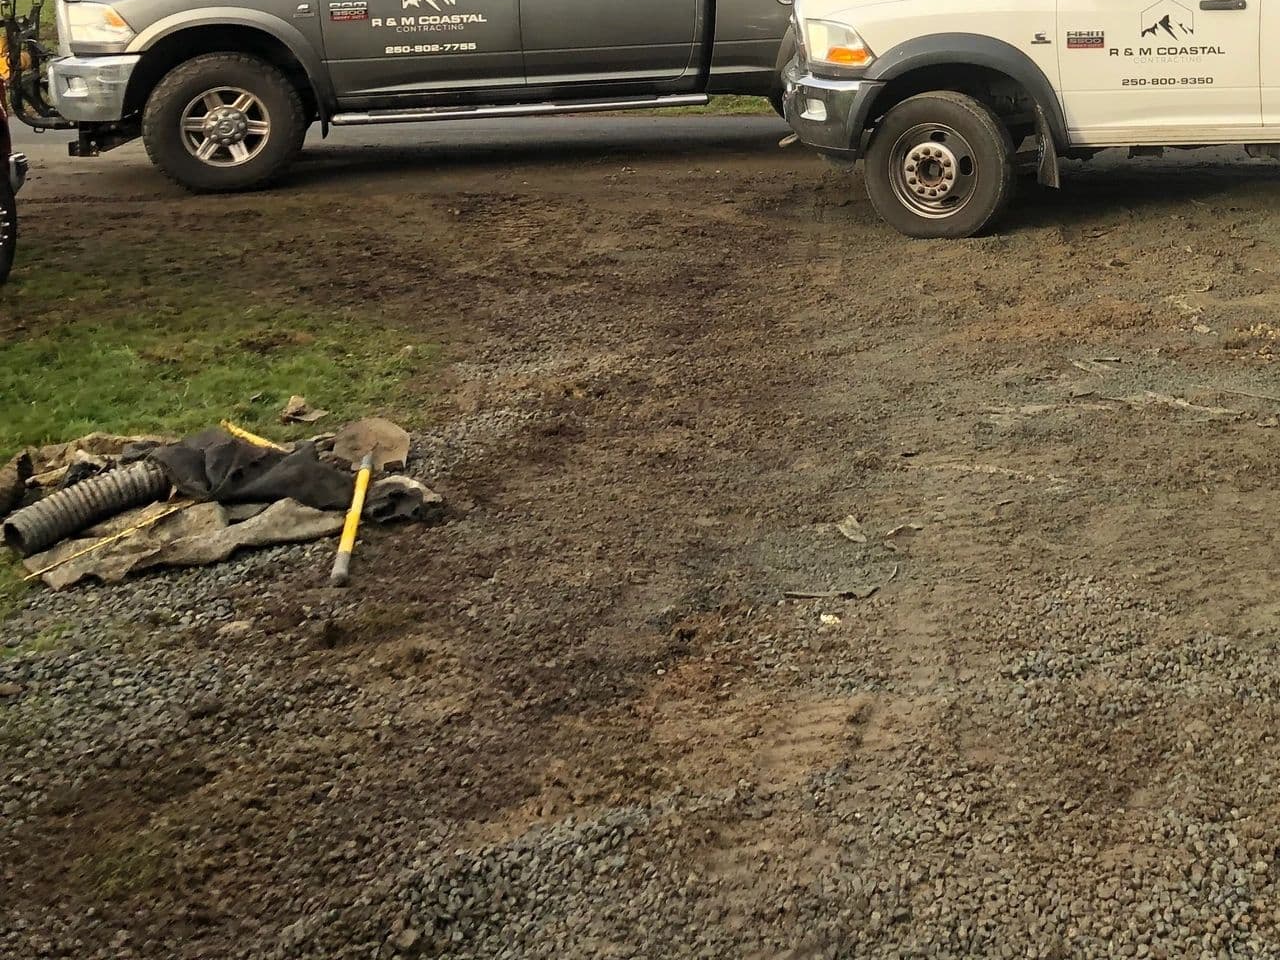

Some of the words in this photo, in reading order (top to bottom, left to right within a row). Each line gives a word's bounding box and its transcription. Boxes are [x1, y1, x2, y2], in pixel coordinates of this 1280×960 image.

[371, 18, 383, 27] R
[386, 17, 397, 26] &
[401, 16, 415, 26] M
[418, 14, 488, 25] COASTAL
[396, 23, 465, 33] CONTRACTING
[1109, 48, 1119, 56] R
[1123, 48, 1134, 56] &
[1139, 47, 1152, 56] M
[1156, 46, 1226, 55] COASTAL
[1133, 56, 1203, 64] CONTRACTING
[1121, 77, 1214, 86] 250-800-9350
